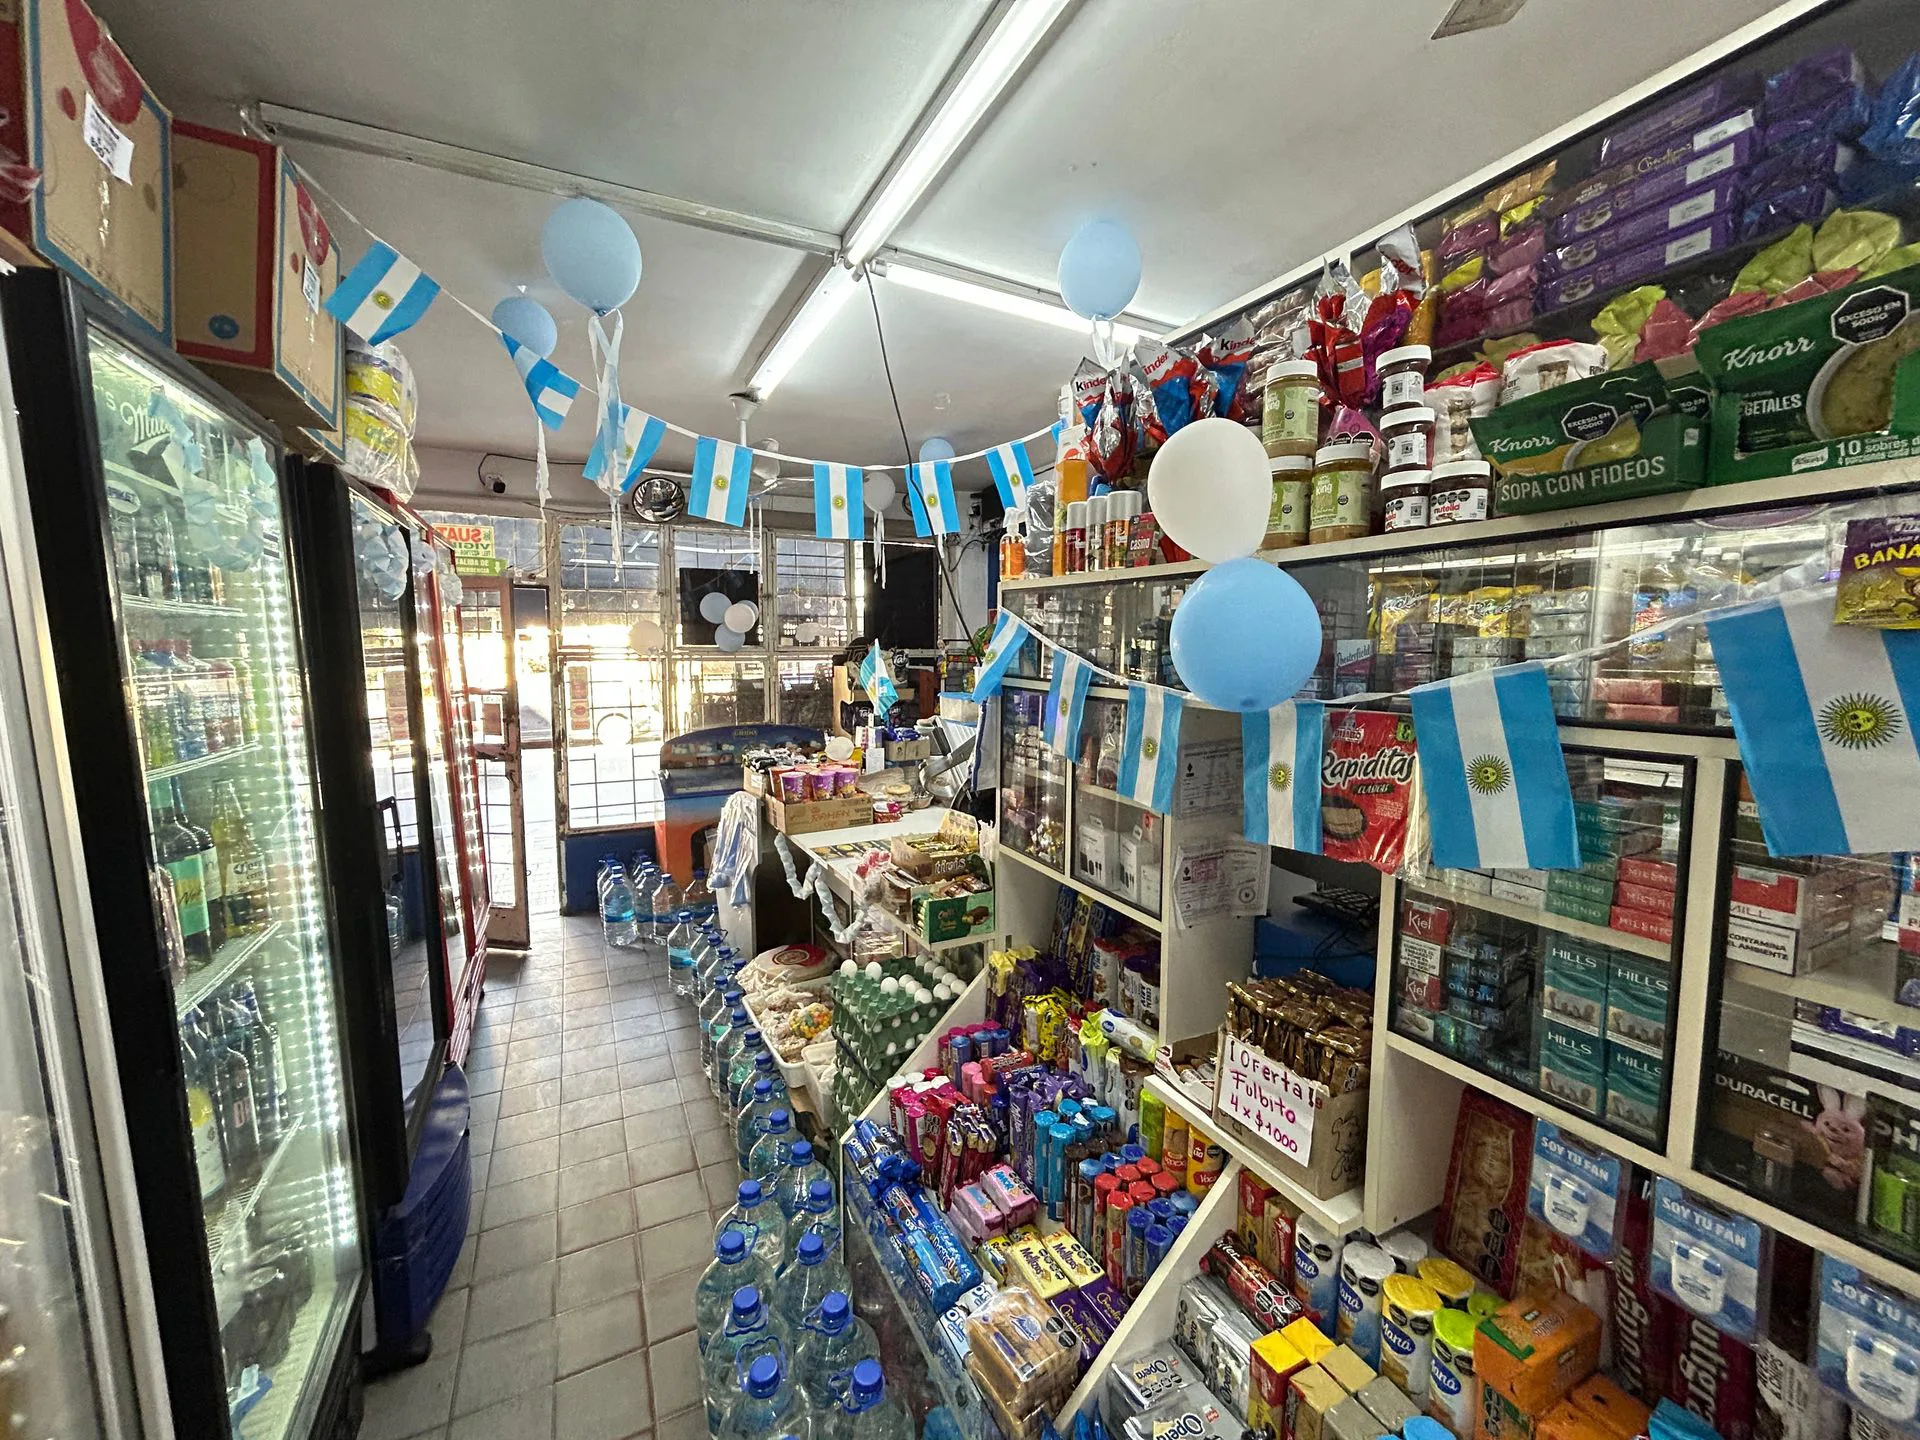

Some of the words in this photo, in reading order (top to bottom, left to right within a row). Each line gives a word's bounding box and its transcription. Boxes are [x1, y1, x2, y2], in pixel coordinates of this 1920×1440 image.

[1838, 305, 1882, 324] EXCESO
[1884, 300, 1902, 311] EN
[1851, 311, 1889, 328] SODIO
[1143, 351, 1169, 375] inder
[1722, 337, 1816, 371] Knorr
[1567, 416, 1598, 428] EXCESO
[1598, 411, 1611, 419] EN
[1577, 420, 1604, 431] SODIO
[1488, 435, 1556, 453] Knorr
[1836, 440, 1861, 457] 10
[1865, 438, 1909, 452] sobres
[1501, 480, 1543, 501] SOPA
[1545, 472, 1585, 495] CON
[1591, 455, 1666, 487] FIDEOS
[1433, 502, 1461, 515] nutella
[1130, 537, 1150, 551] casino
[1322, 746, 1417, 789] Rapiditas
[1552, 897, 1602, 919] MILENIO
[1408, 910, 1433, 936] Kiel
[1729, 932, 1787, 951] CONTAMINA
[1738, 943, 1789, 960] AMBIENTE
[1552, 948, 1597, 968] HILLS
[1405, 976, 1427, 1002] Kiel
[1618, 968, 1670, 991] HILLS
[1547, 1031, 1593, 1055] HILLS
[1616, 1053, 1663, 1077] HILLS
[1230, 1069, 1296, 1124] Fulbito
[1714, 1073, 1814, 1120] DURACELL
[1230, 1093, 1239, 1112] 4
[1254, 1109, 1298, 1153] $1000
[849, 1138, 868, 1159] OREO
[1541, 1136, 1565, 1156] SOY
[1567, 1149, 1583, 1166] TU
[1583, 1158, 1609, 1182] FAN
[994, 1170, 1014, 1191] AMOR
[1661, 1197, 1691, 1220] SOY
[1693, 1211, 1712, 1231] TU
[1714, 1224, 1747, 1249] FAN
[1019, 1247, 1044, 1275] Mellizas
[1052, 1242, 1078, 1271] Mellizas
[1096, 1292, 1123, 1323] Chocolin
[1831, 1278, 1870, 1306] SOY
[1876, 1298, 1901, 1321] TU
[1135, 1359, 1168, 1380] Opera
[1219, 1366, 1232, 1404] Opera
